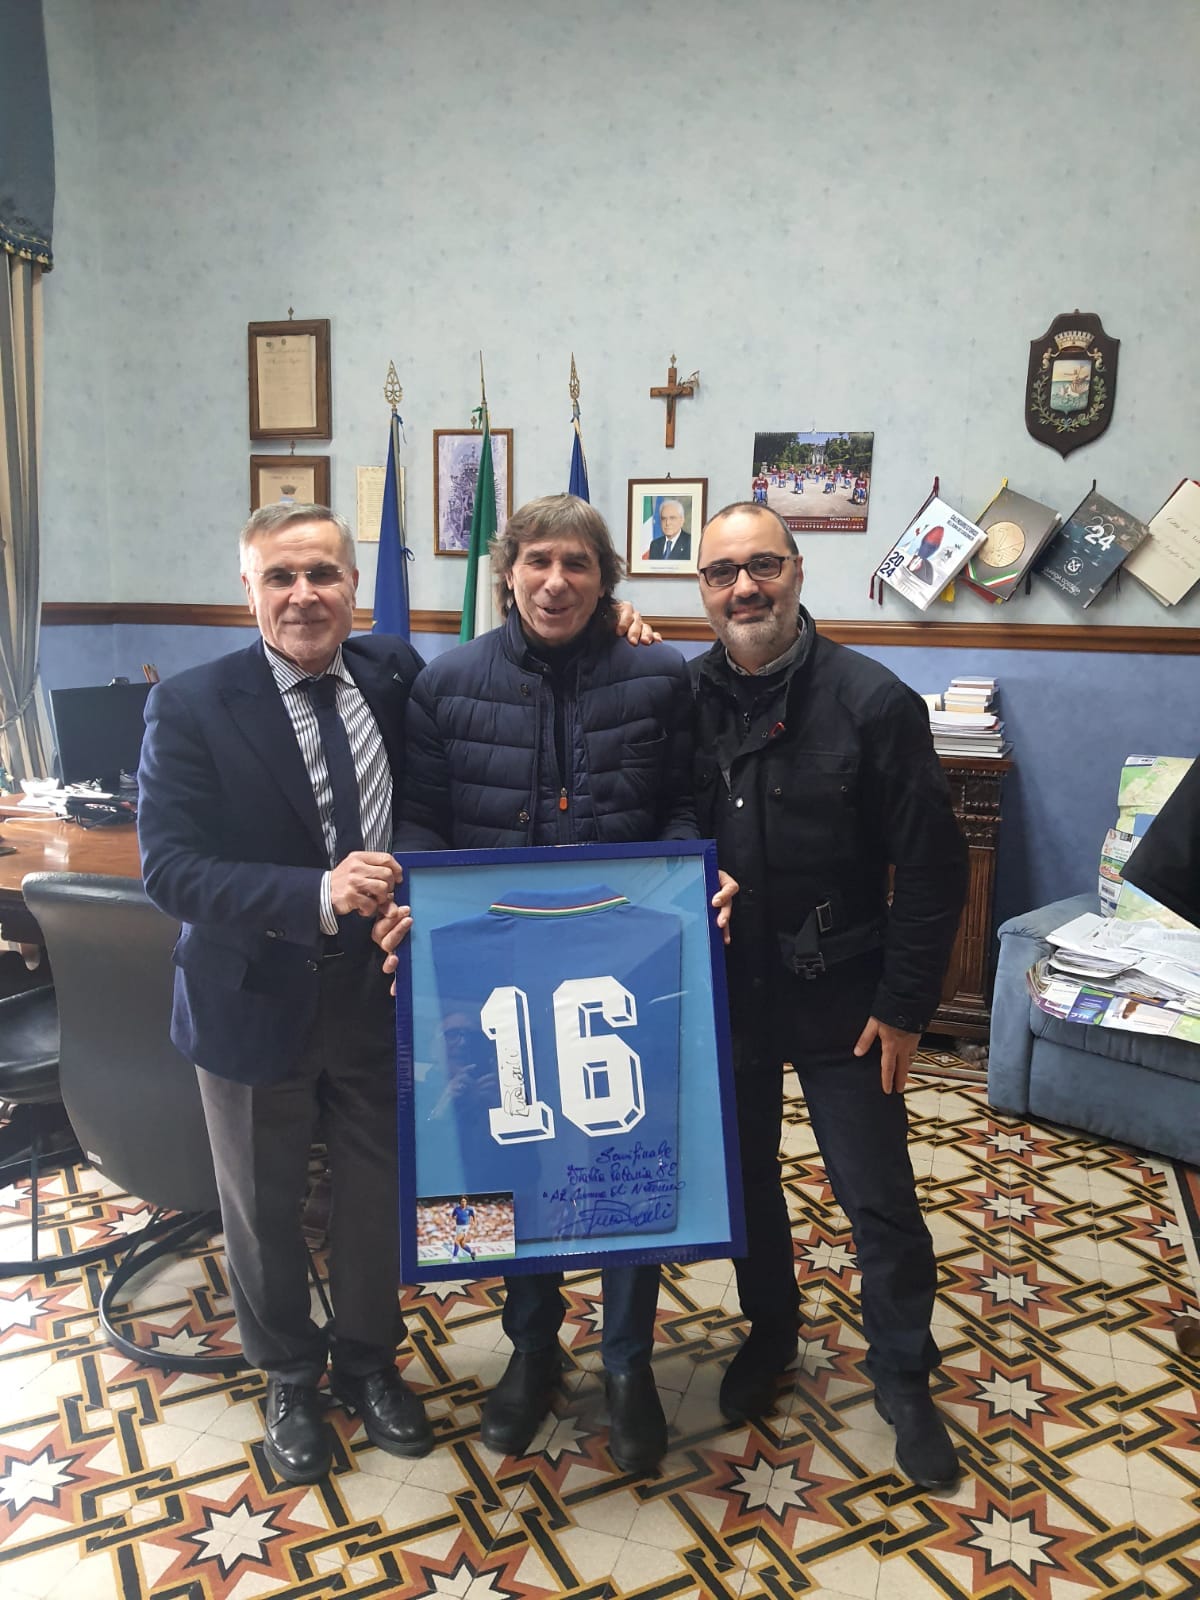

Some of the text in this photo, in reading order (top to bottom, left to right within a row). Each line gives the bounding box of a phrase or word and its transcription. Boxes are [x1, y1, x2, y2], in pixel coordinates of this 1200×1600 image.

[1084, 525, 1116, 551] 24
[888, 551, 905, 567] 20
[879, 562, 896, 578] 24
[480, 976, 646, 1145] 16
